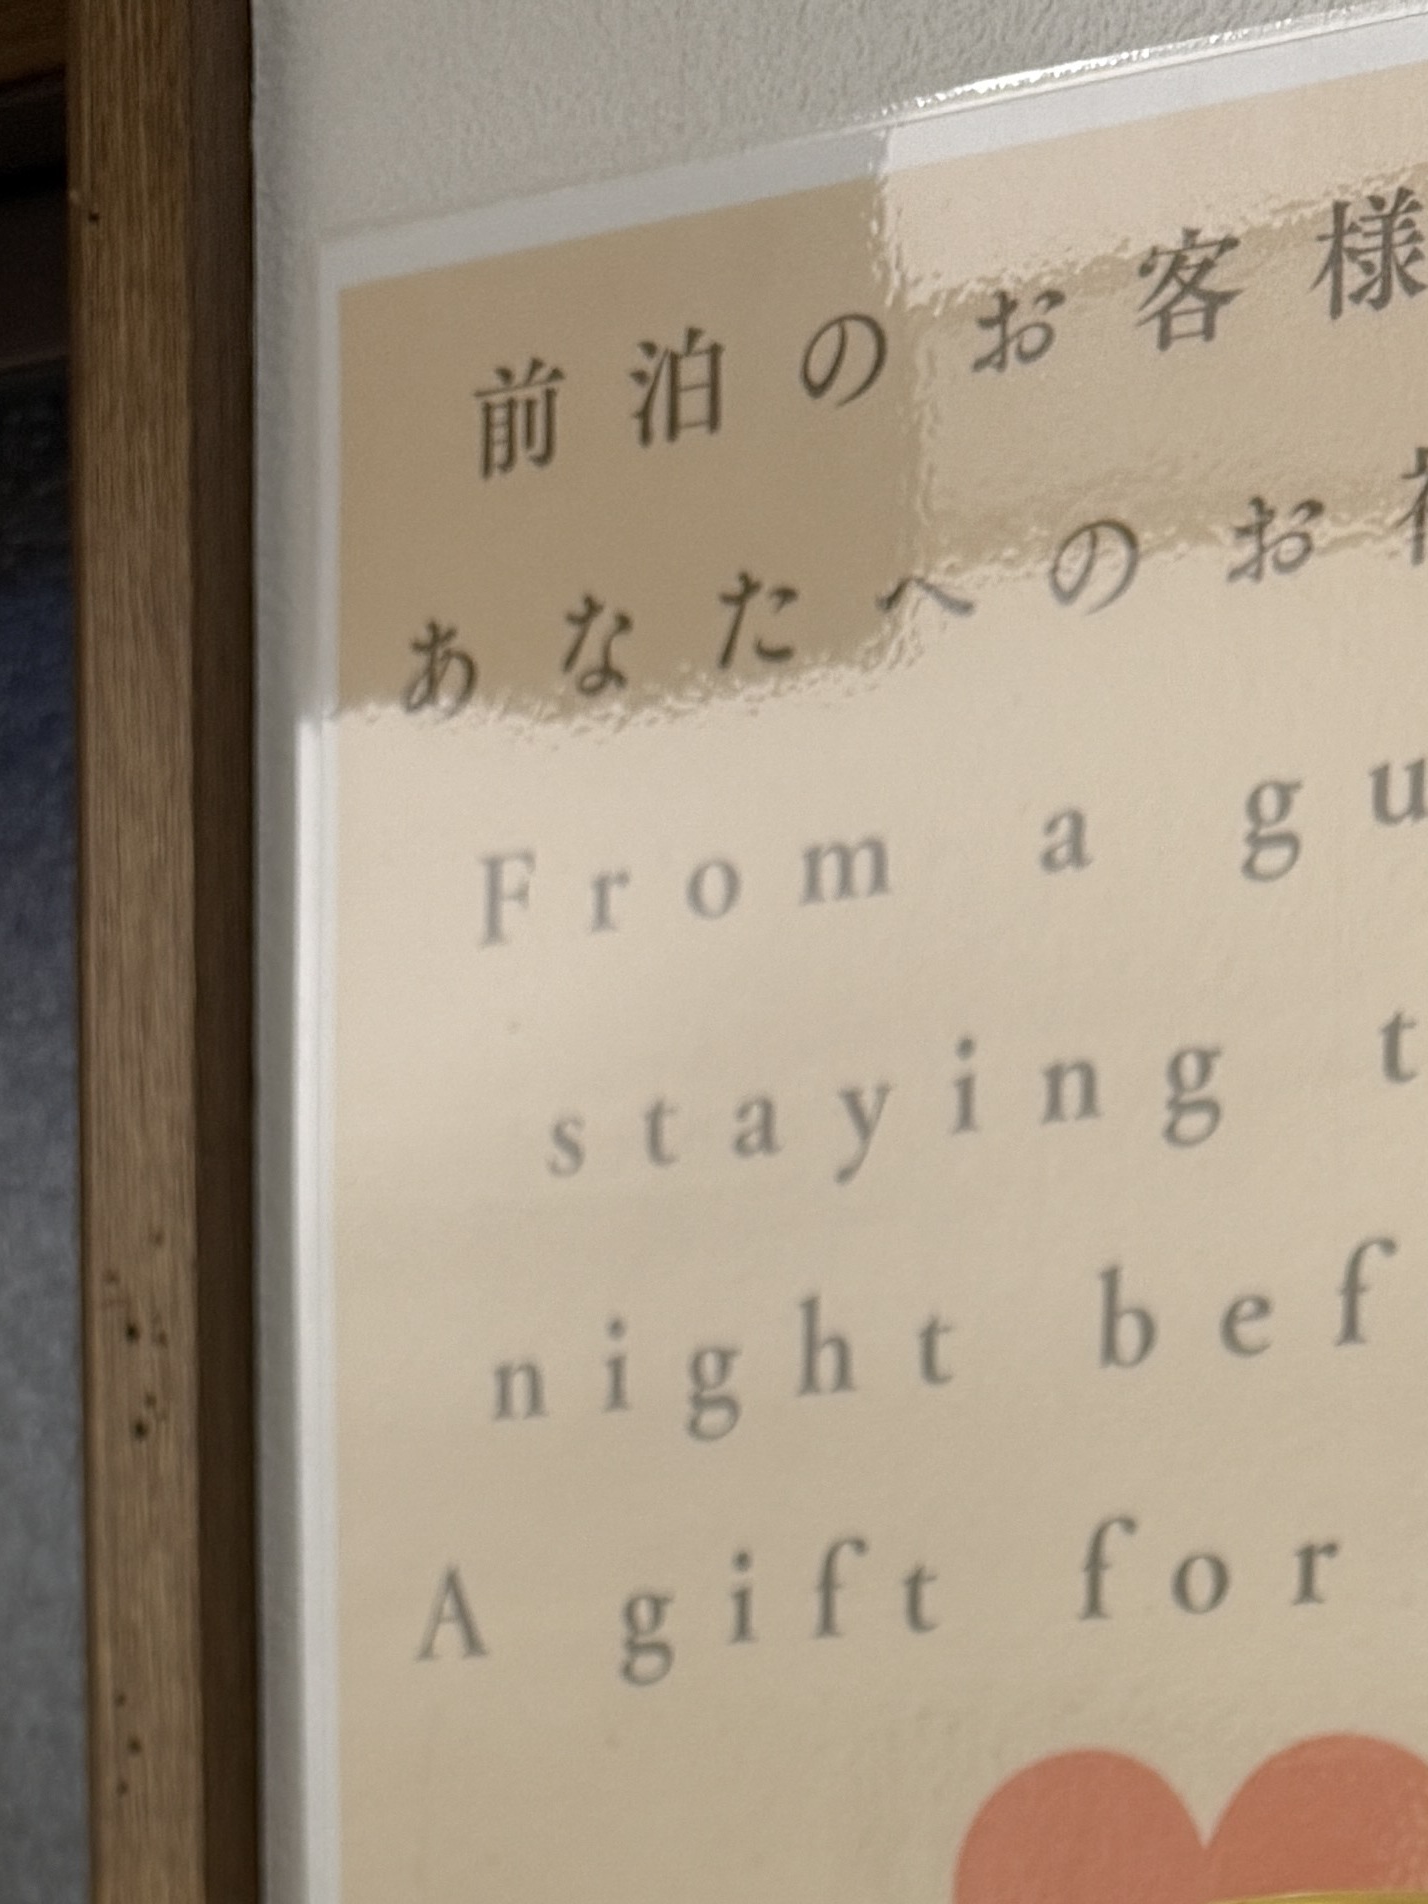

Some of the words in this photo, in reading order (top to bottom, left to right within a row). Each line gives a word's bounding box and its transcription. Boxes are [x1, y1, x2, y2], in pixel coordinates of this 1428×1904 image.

[482, 828, 893, 947] From
[1040, 809, 1092, 876] a
[547, 1037, 1224, 1184] staying
[493, 1295, 957, 1440] night
[417, 1565, 490, 1660] A
[619, 1536, 942, 1684] gift
[1075, 1518, 1342, 1621] for
